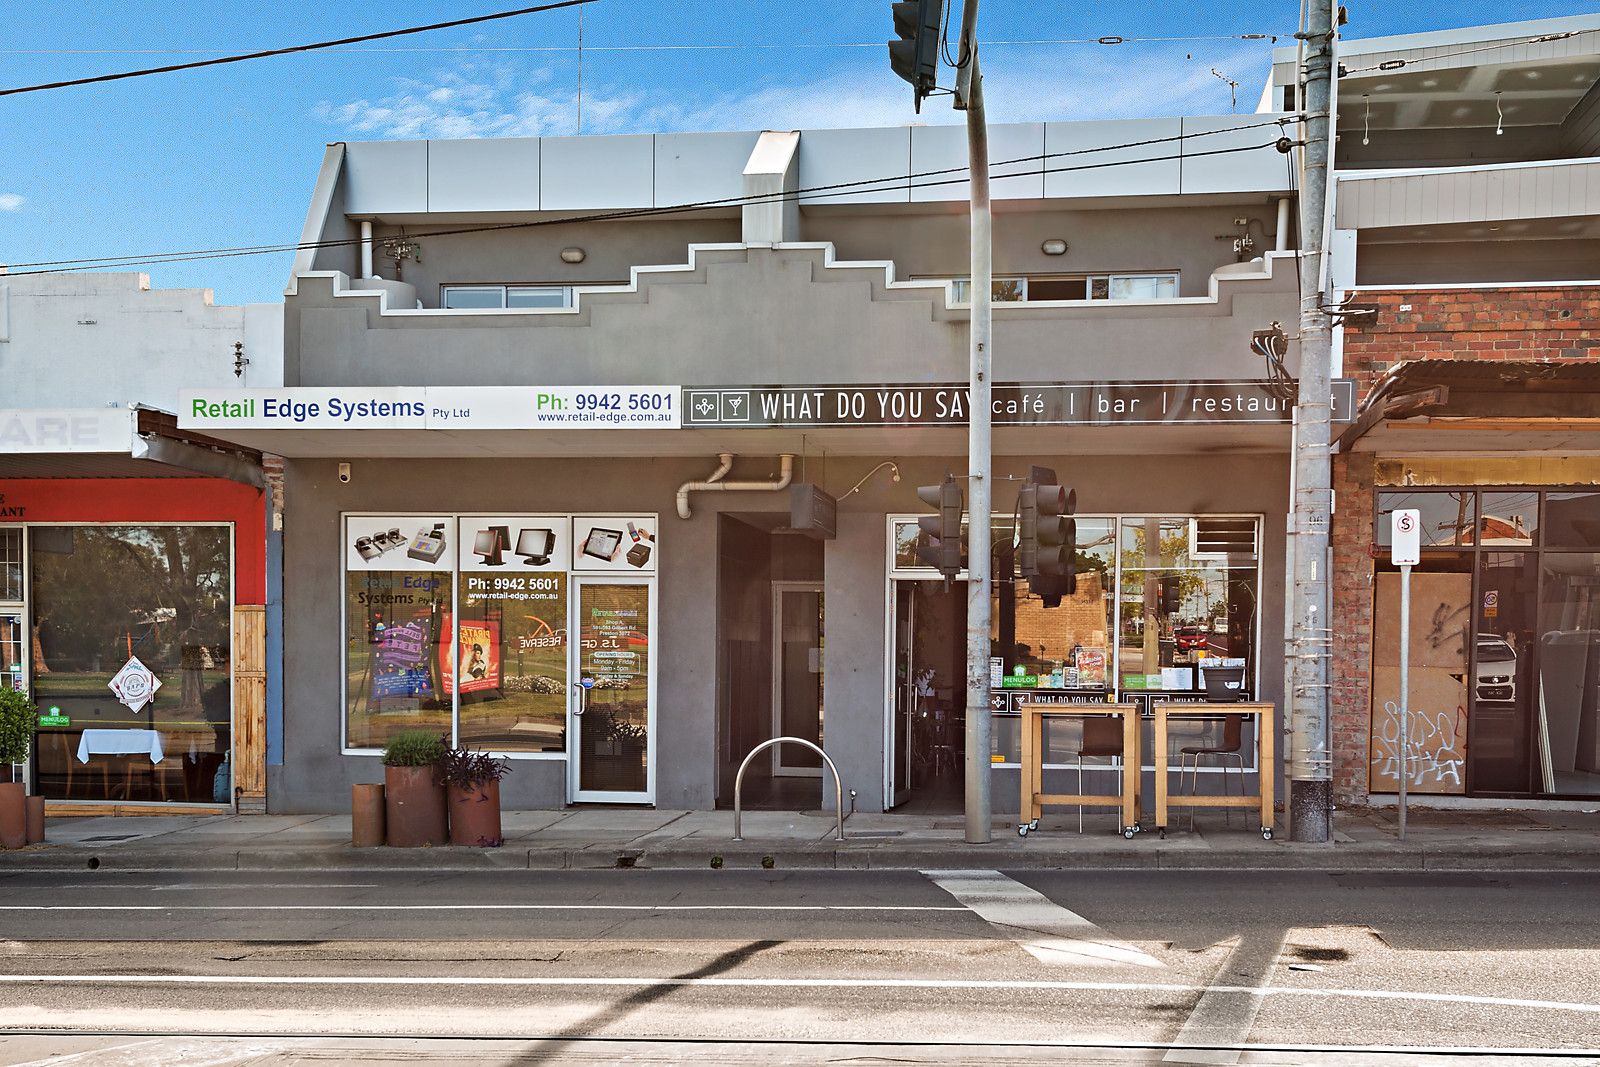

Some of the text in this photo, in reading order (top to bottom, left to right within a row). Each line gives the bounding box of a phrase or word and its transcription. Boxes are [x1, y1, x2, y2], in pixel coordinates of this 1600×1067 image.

[192, 397, 470, 422] Retail Edge Systems Pty Ltd
[537, 393, 672, 411] Ph: 9942 5601
[760, 392, 825, 419] WHAT
[837, 391, 866, 419] DO
[877, 391, 923, 419] YOU
[991, 393, 1337, 414] café bar restaurt
[537, 411, 672, 423] www.retail-edge.com.au
[403, 575, 440, 592] Edge
[468, 578, 559, 590] Ph: 9942 5601
[358, 592, 414, 606] Systems
[468, 592, 559, 601] www.retail-edge.com.au
[1034, 695, 1056, 704] WHAT
